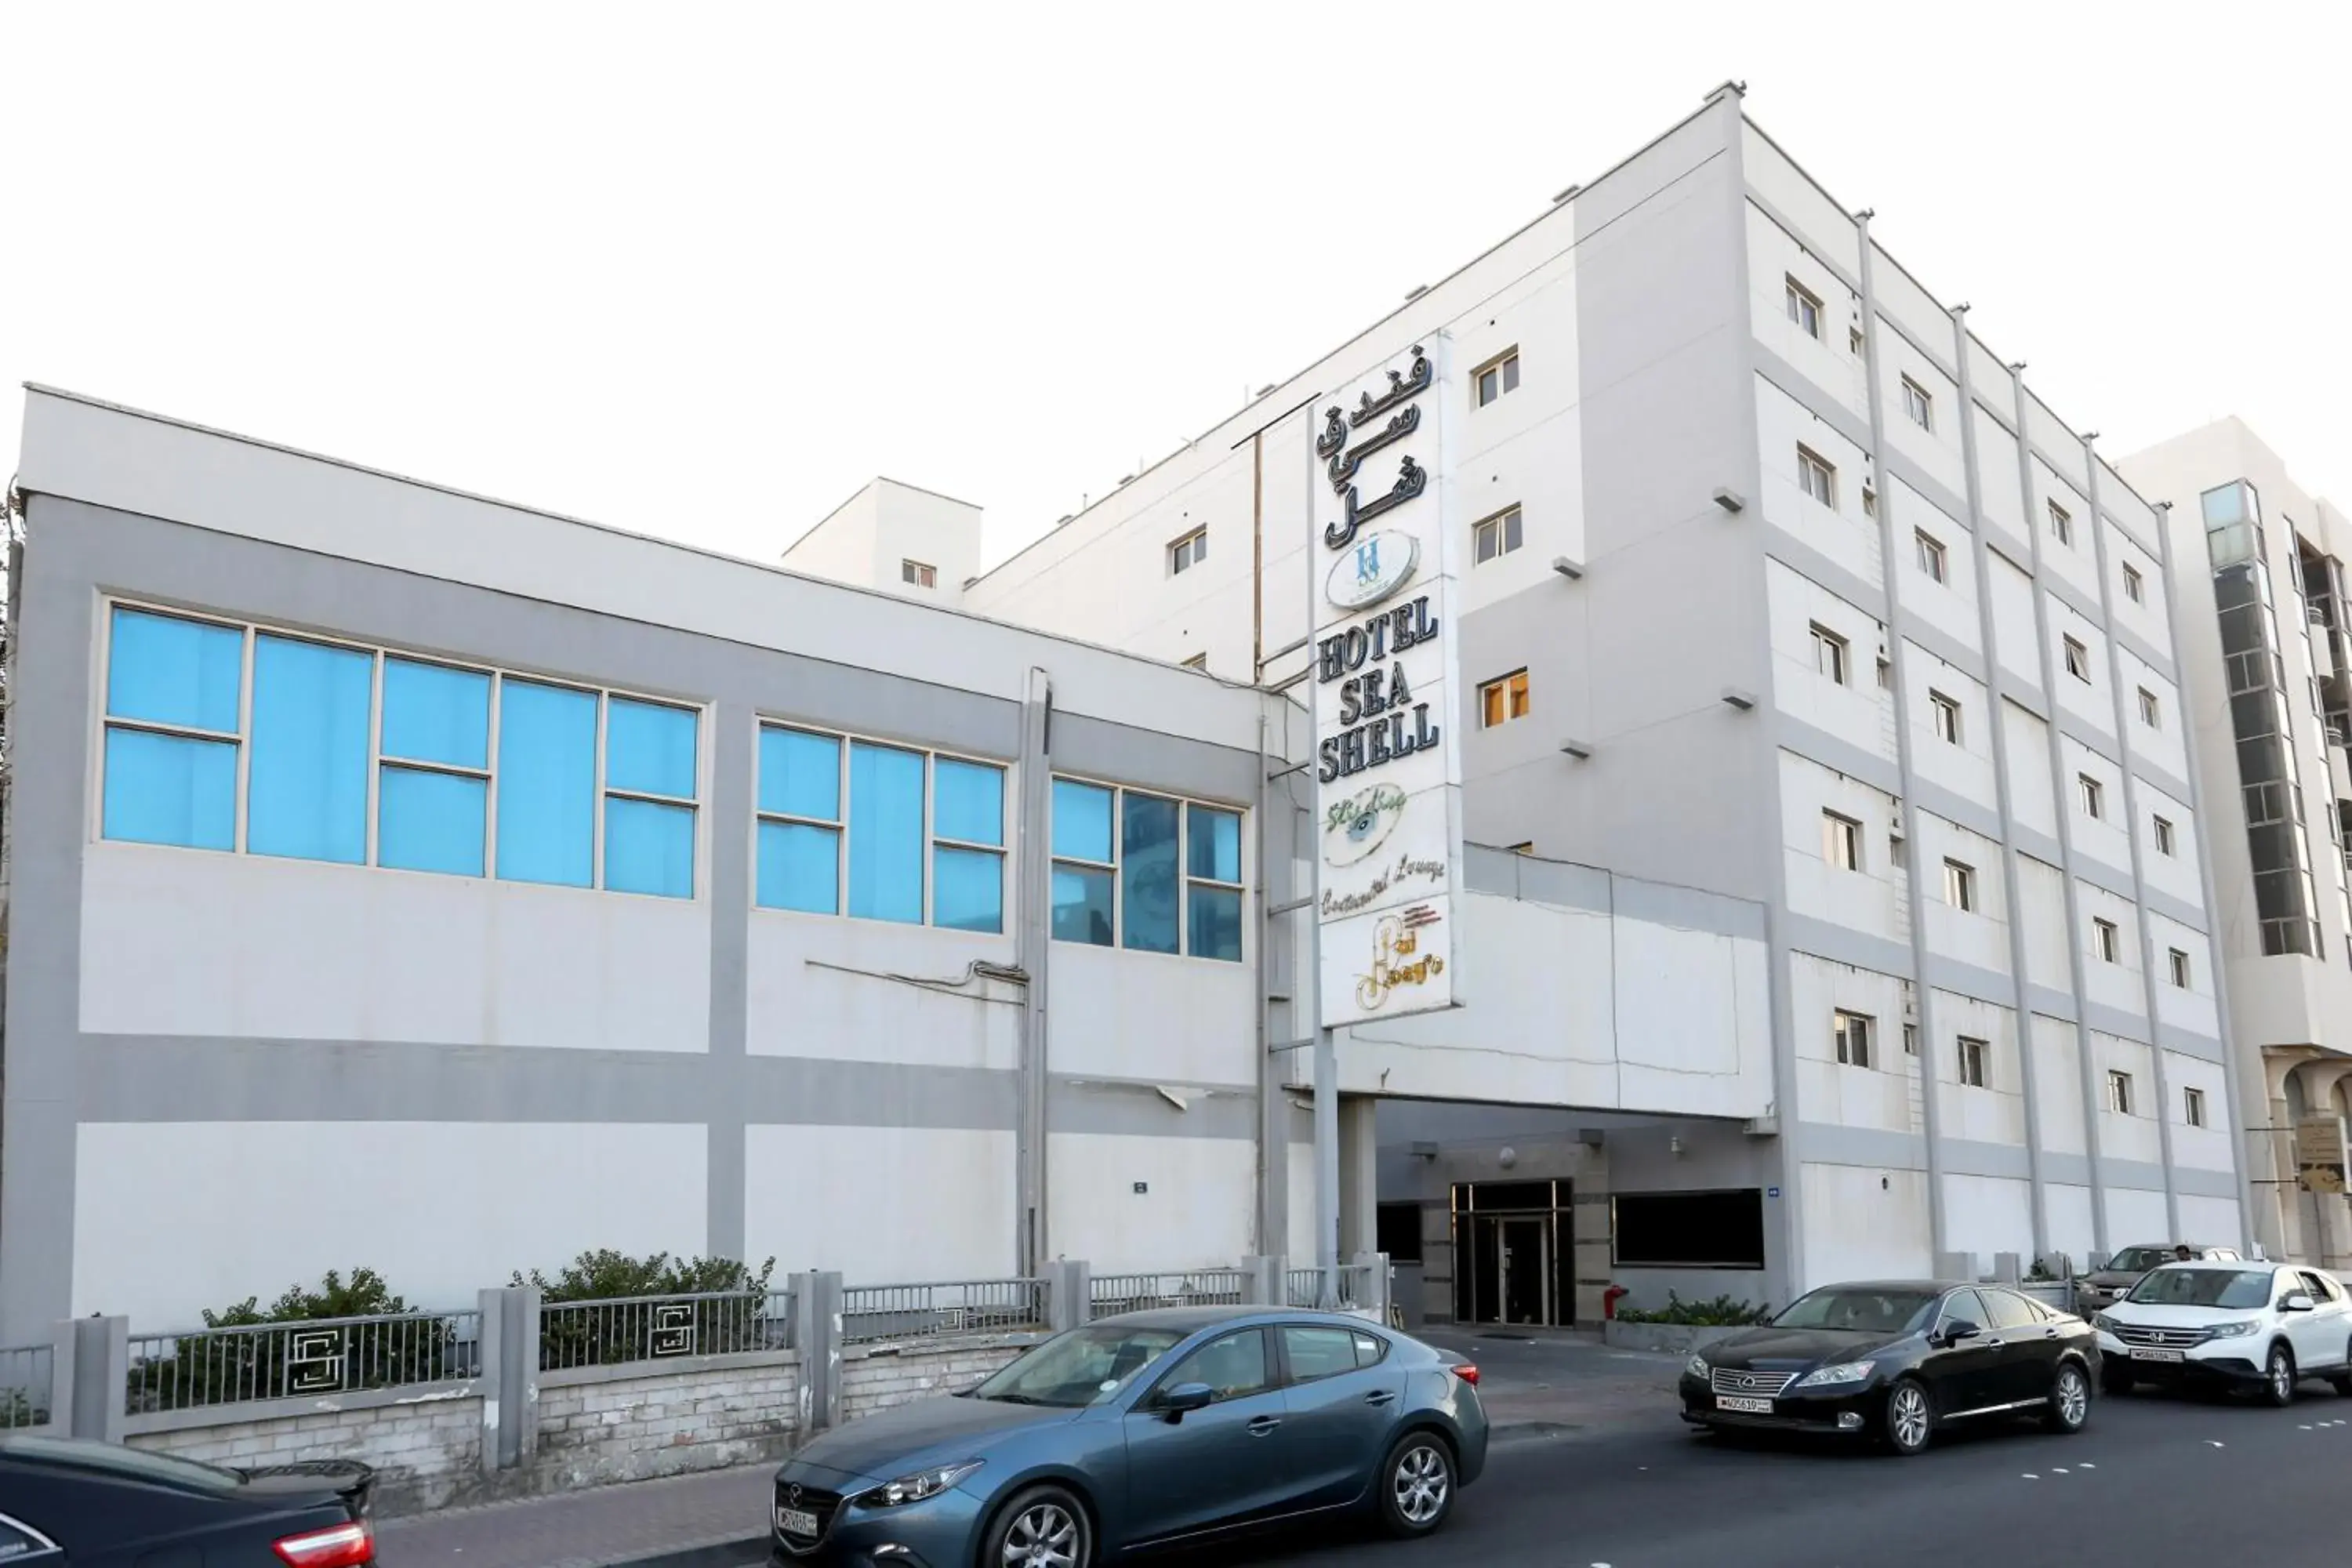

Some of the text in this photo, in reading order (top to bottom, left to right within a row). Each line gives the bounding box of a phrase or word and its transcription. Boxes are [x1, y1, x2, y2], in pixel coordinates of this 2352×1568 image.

[1316, 344, 1432, 459] فندق
[1328, 403, 1421, 495] سي
[1325, 455, 1427, 550] شل
[1317, 596, 1439, 684] HOTEL
[1340, 661, 1412, 726] SEA
[1318, 702, 1439, 784] SHELL
